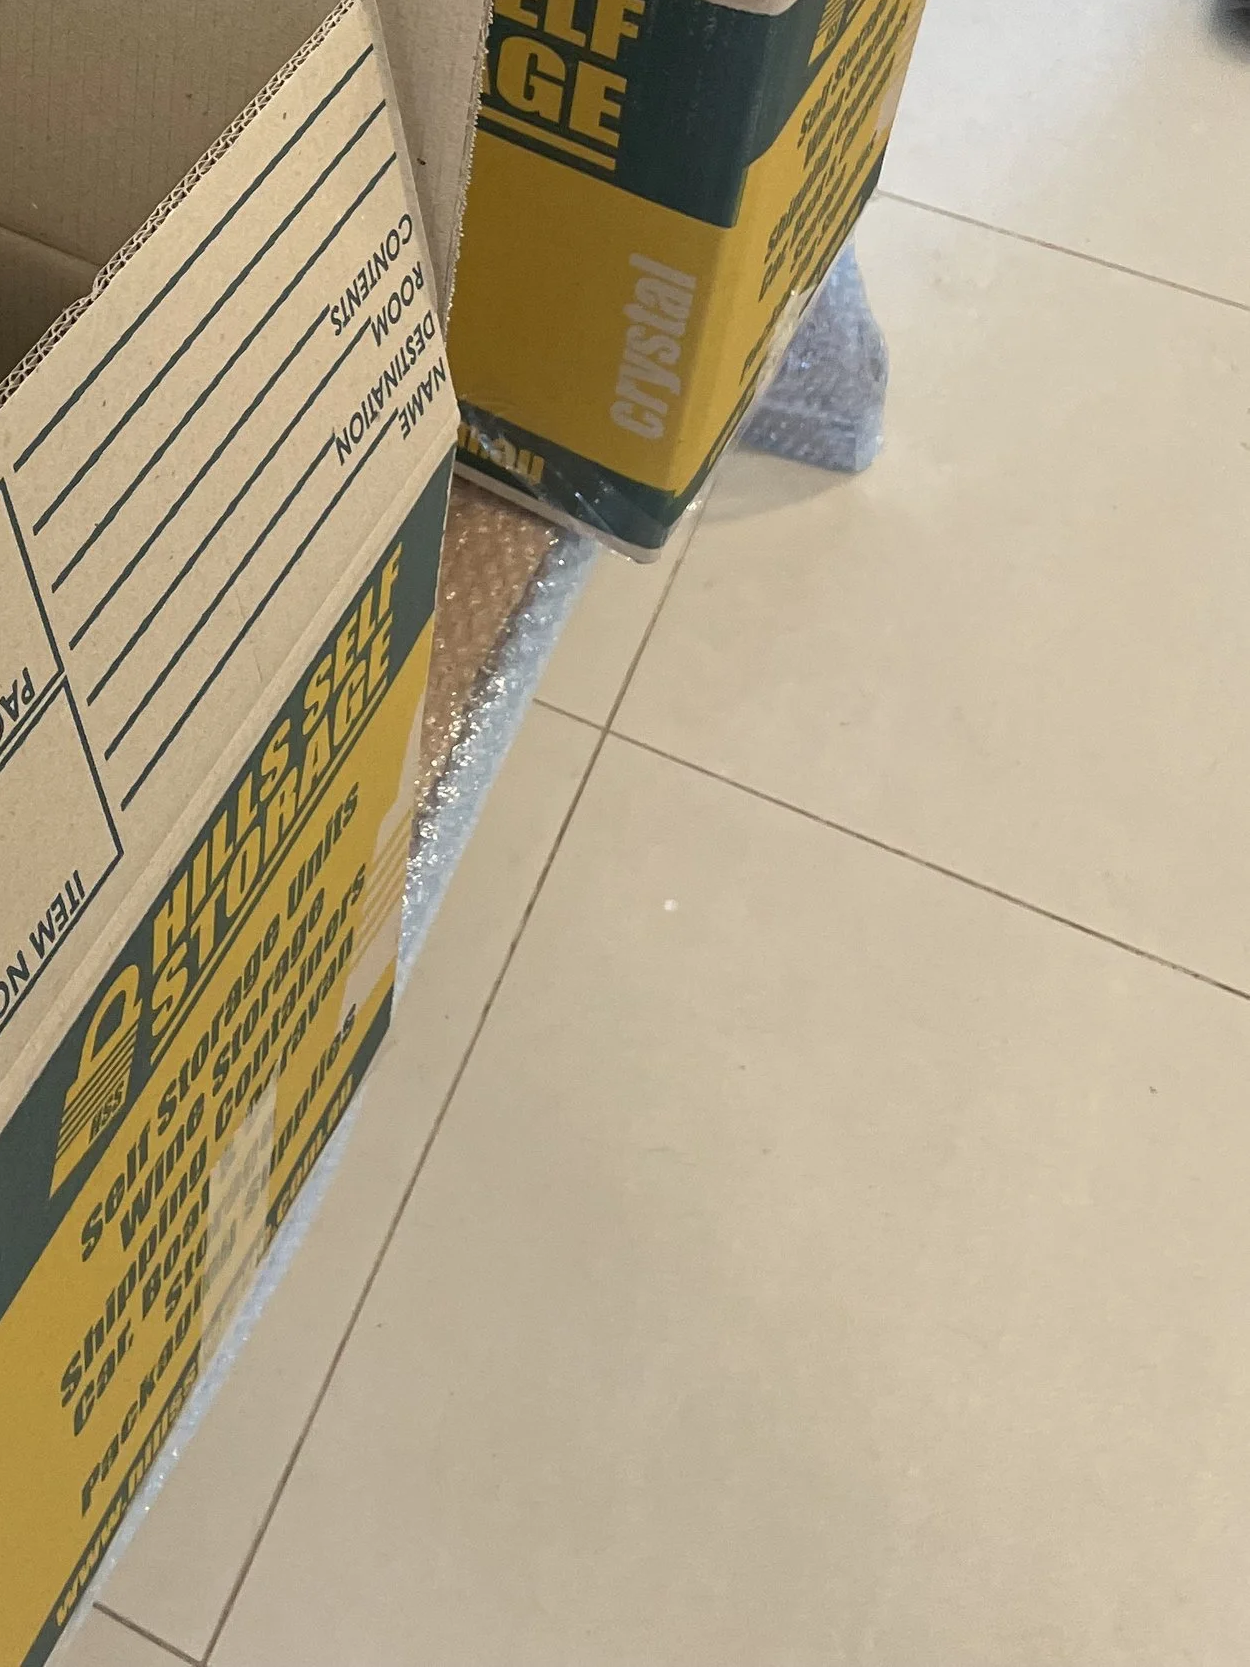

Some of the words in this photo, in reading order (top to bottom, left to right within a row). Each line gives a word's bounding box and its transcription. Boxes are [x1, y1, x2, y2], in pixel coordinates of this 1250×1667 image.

[330, 214, 413, 336] CONTENTS
[370, 261, 424, 348] ROOM
[609, 253, 697, 441] crystal
[334, 310, 436, 466] DESTINATION
[400, 357, 447, 440] NAME
[151, 611, 393, 1038] STORAGE
[153, 718, 291, 976] HILLS
[303, 541, 403, 728] SELF
[29, 869, 84, 961] ITEM
[81, 1118, 151, 1263] Self
[157, 913, 281, 1137] Storage
[287, 781, 359, 921] Units
[61, 1136, 207, 1408] Shipping
[215, 861, 366, 1143] Containers
[120, 1092, 205, 1252] Wine
[213, 887, 325, 1098] Storage
[74, 1317, 135, 1437] Car,
[141, 1177, 210, 1322] Boat
